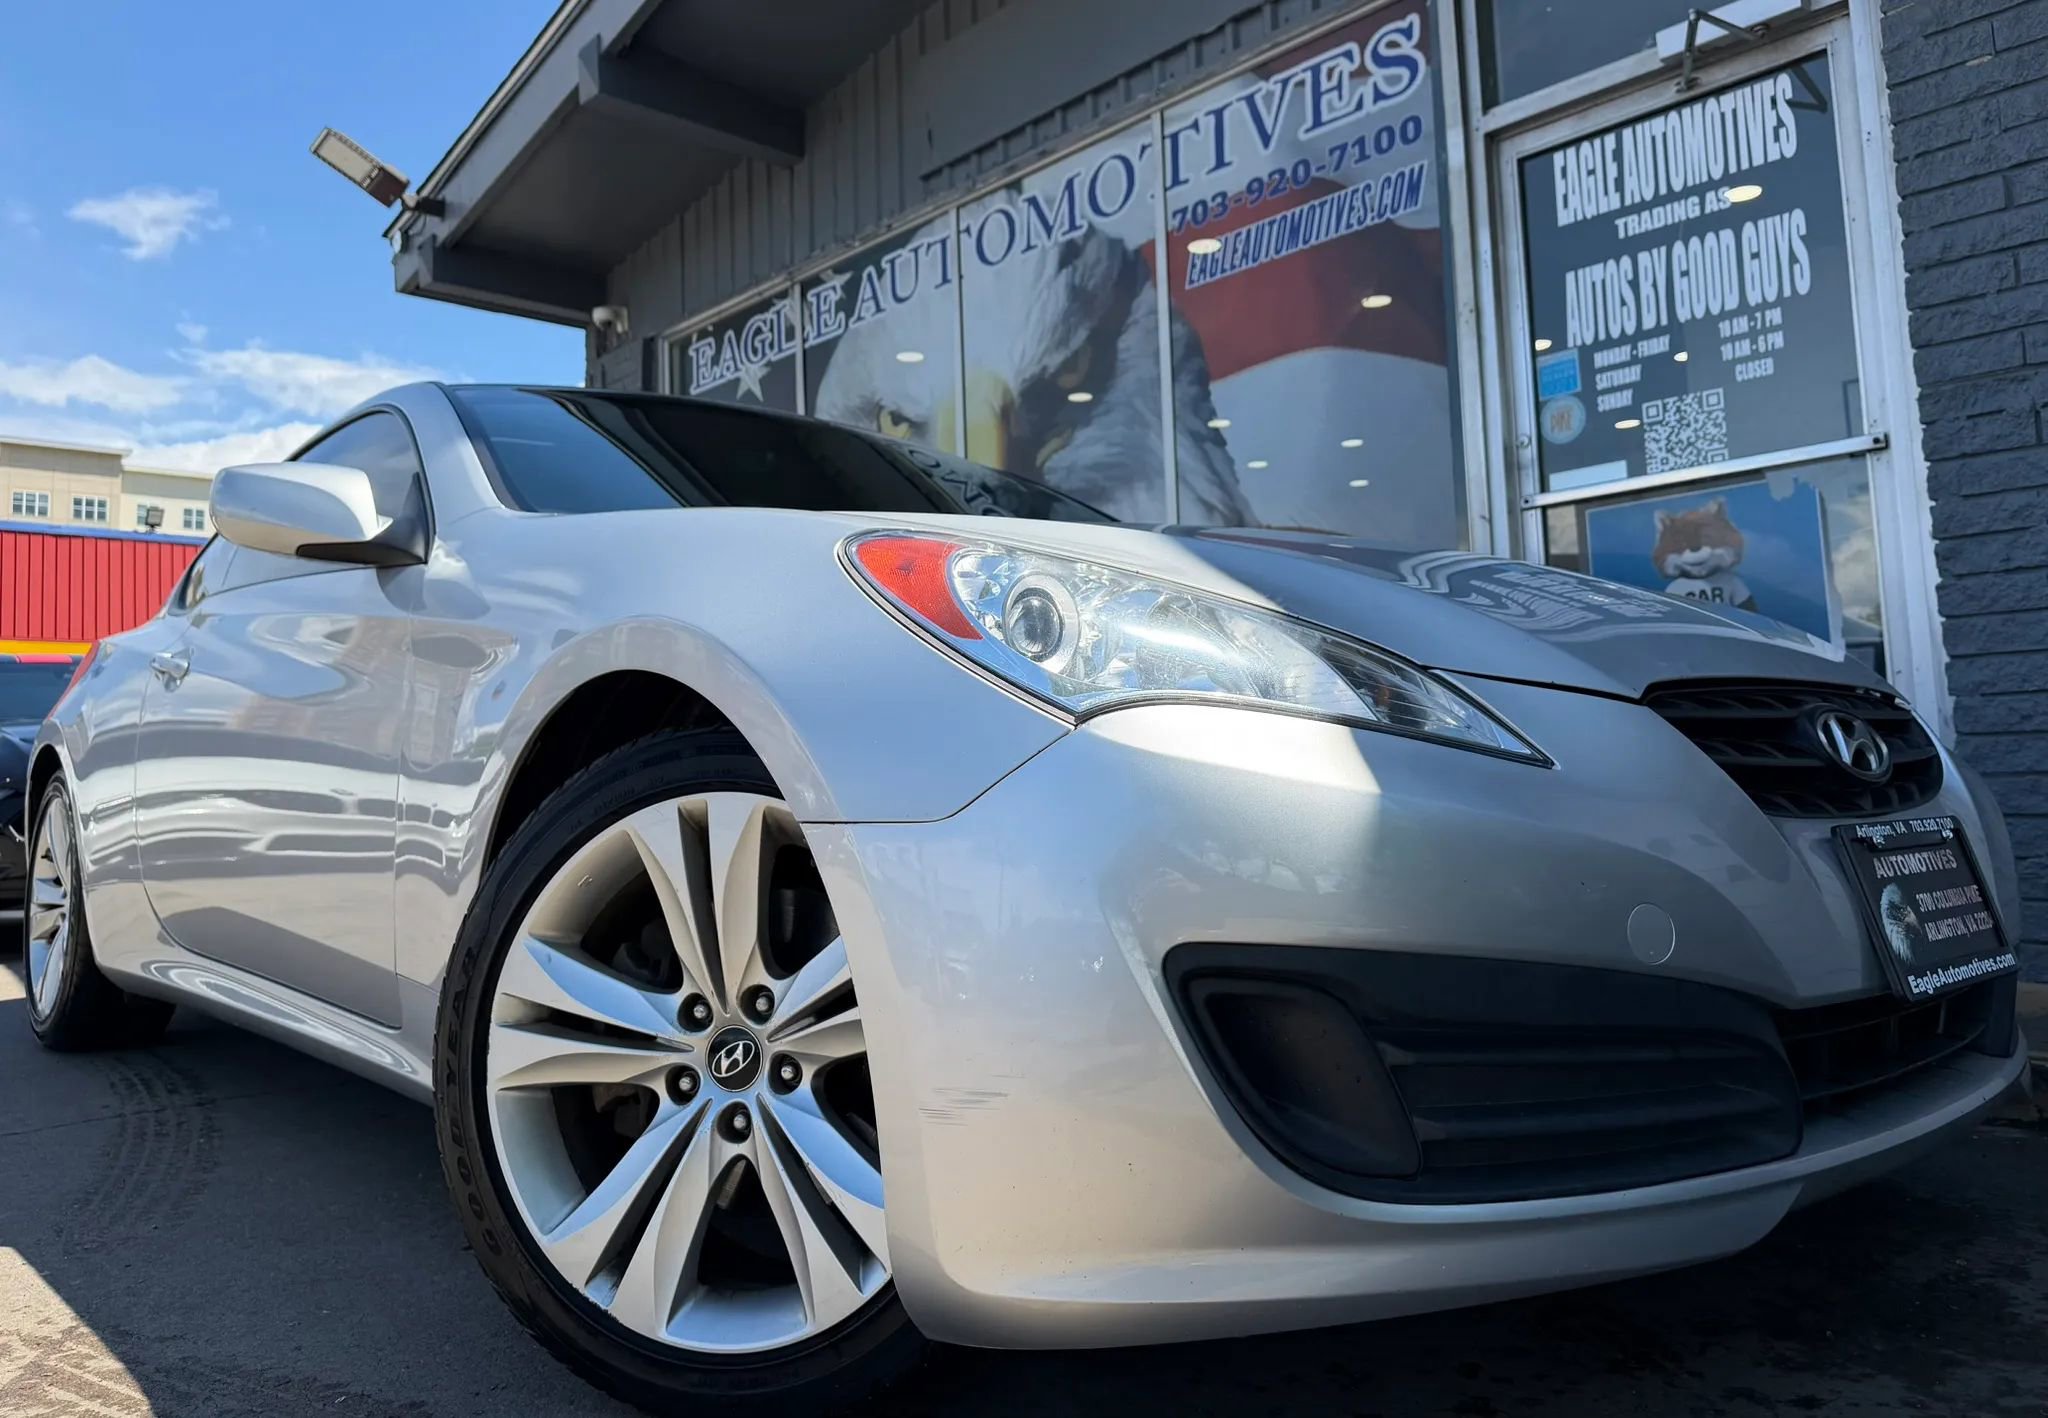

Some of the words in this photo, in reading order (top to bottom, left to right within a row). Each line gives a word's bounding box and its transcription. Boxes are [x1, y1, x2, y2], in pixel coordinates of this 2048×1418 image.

[689, 281, 846, 395] EAGLE
[850, 12, 1427, 327] AUTOMOTIVES
[1172, 115, 1423, 235] 703-920-7100
[1553, 132, 1621, 227] EAGLE
[1622, 72, 1798, 206] AUTOMOTIVES
[1185, 160, 1428, 290] EAGLEAUTOMOTIVES.COM
[1614, 195, 1701, 239] TRADING
[1704, 186, 1732, 214] AS
[1565, 254, 1637, 348] AUTOS
[1637, 245, 1668, 331] BY
[1672, 228, 1741, 324] GOOD
[1741, 208, 1812, 307] GUYS
[1873, 849, 1957, 879] AUTOMOTIVES
[1907, 953, 2017, 995] EagleAutomotives.com
